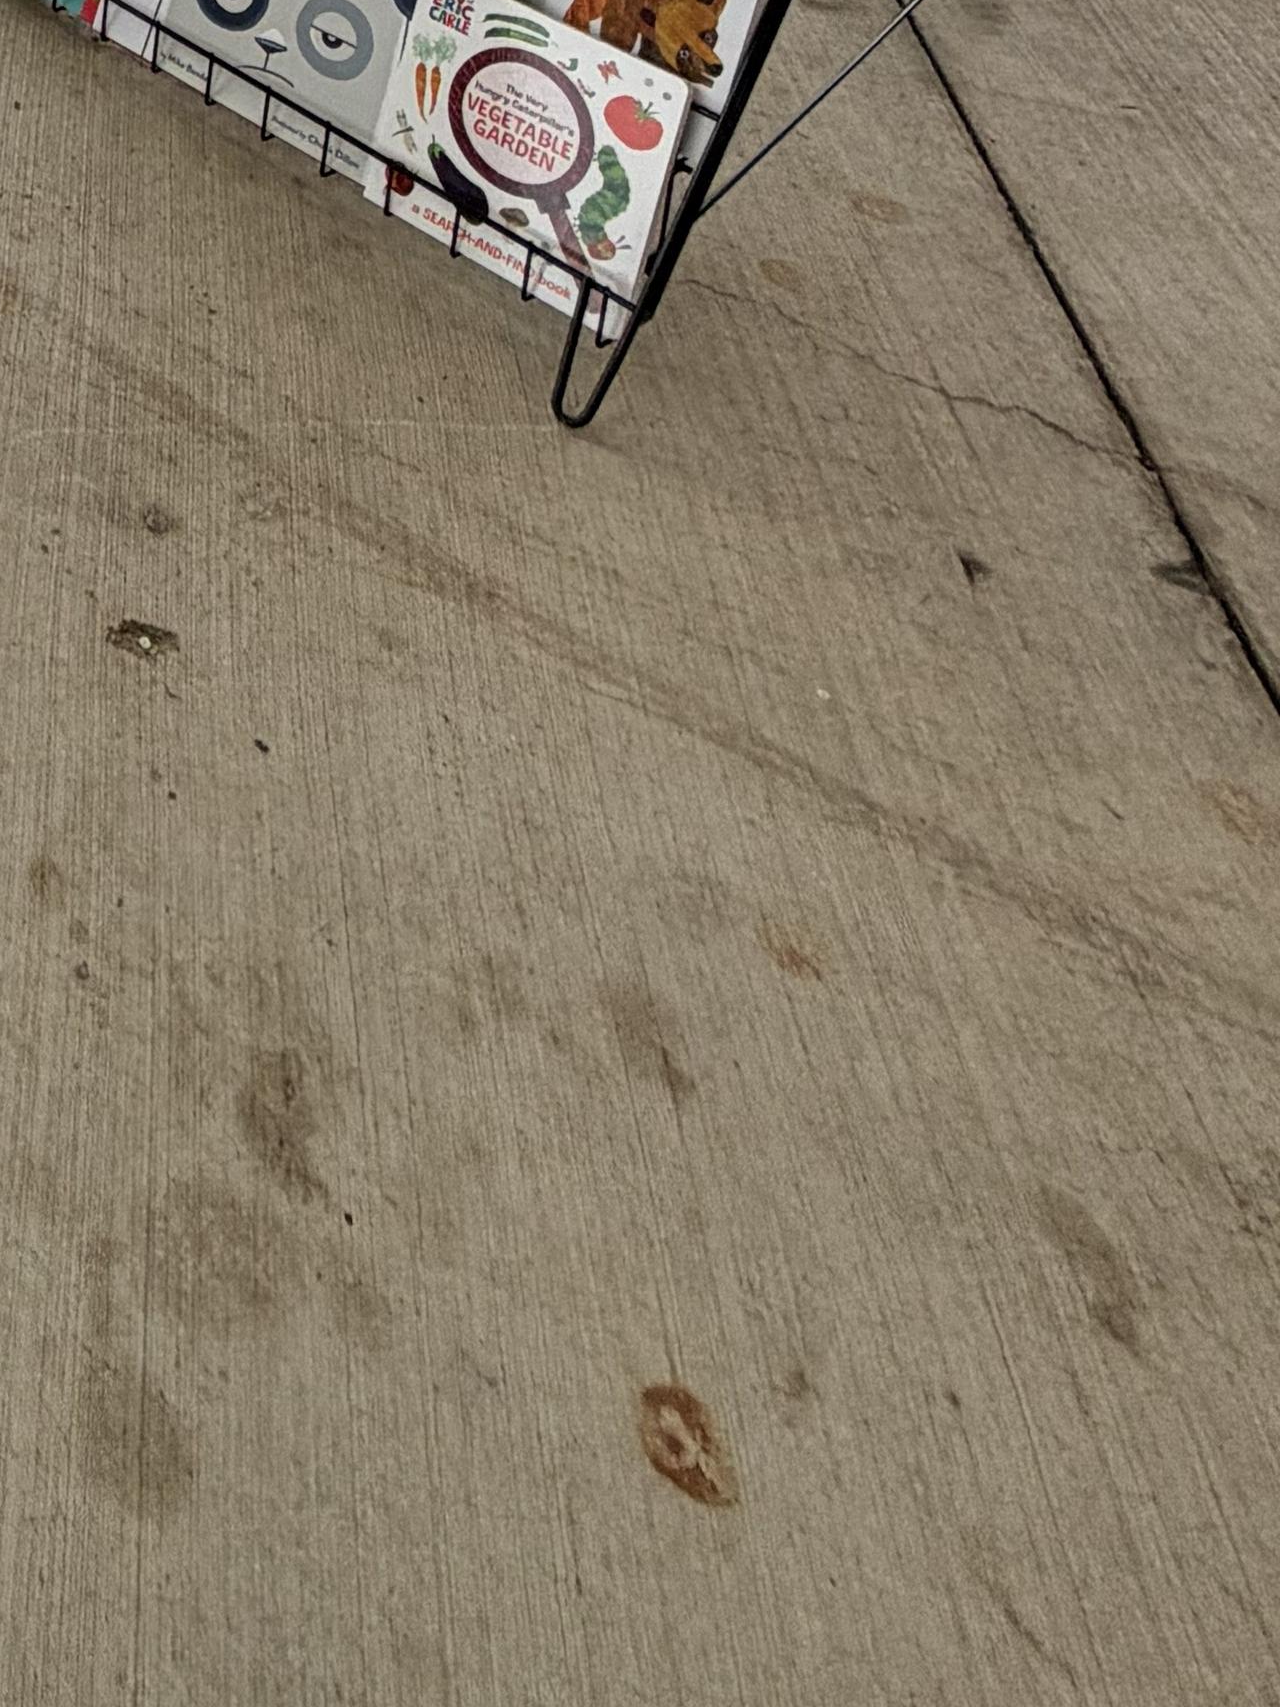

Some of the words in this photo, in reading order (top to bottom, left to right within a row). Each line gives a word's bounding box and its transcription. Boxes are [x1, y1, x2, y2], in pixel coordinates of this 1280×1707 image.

[428, 5, 472, 36] CARLE
[474, 80, 511, 106] Hungry
[506, 83, 524, 99] The
[526, 94, 549, 112] Very
[466, 92, 573, 161] VEGETABLE
[473, 119, 556, 173] GARDEN
